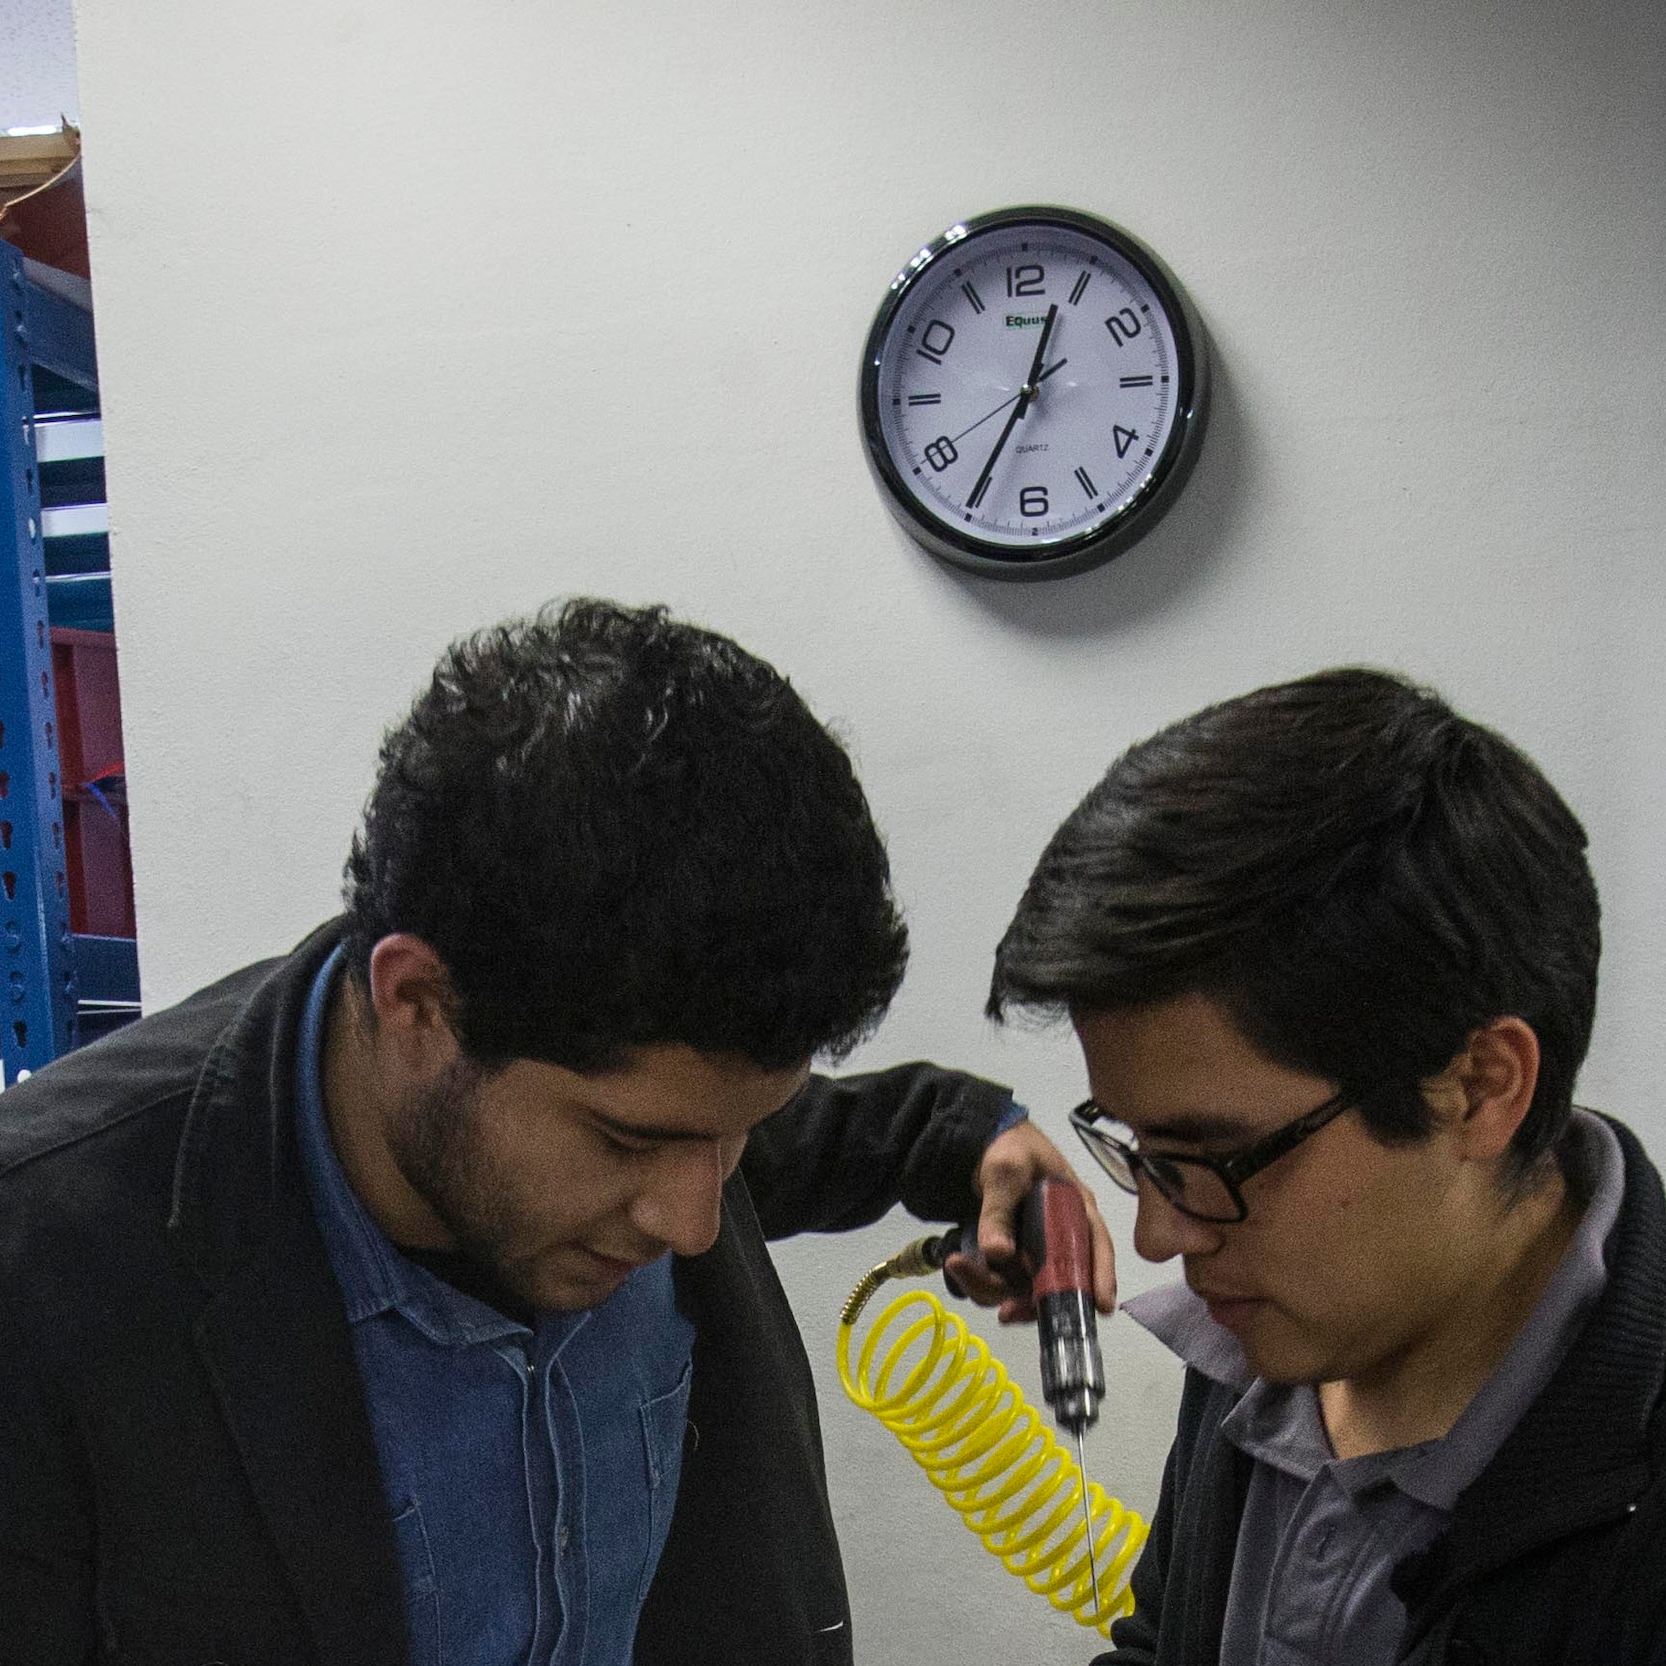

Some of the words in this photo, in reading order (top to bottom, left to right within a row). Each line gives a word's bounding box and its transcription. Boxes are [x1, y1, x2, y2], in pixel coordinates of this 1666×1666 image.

[1006, 265, 1046, 298] 12
[916, 319, 955, 365] 10
[1104, 307, 1142, 347] 2
[923, 435, 959, 472] 8
[1112, 424, 1140, 458] 4
[1019, 486, 1049, 517] 6
